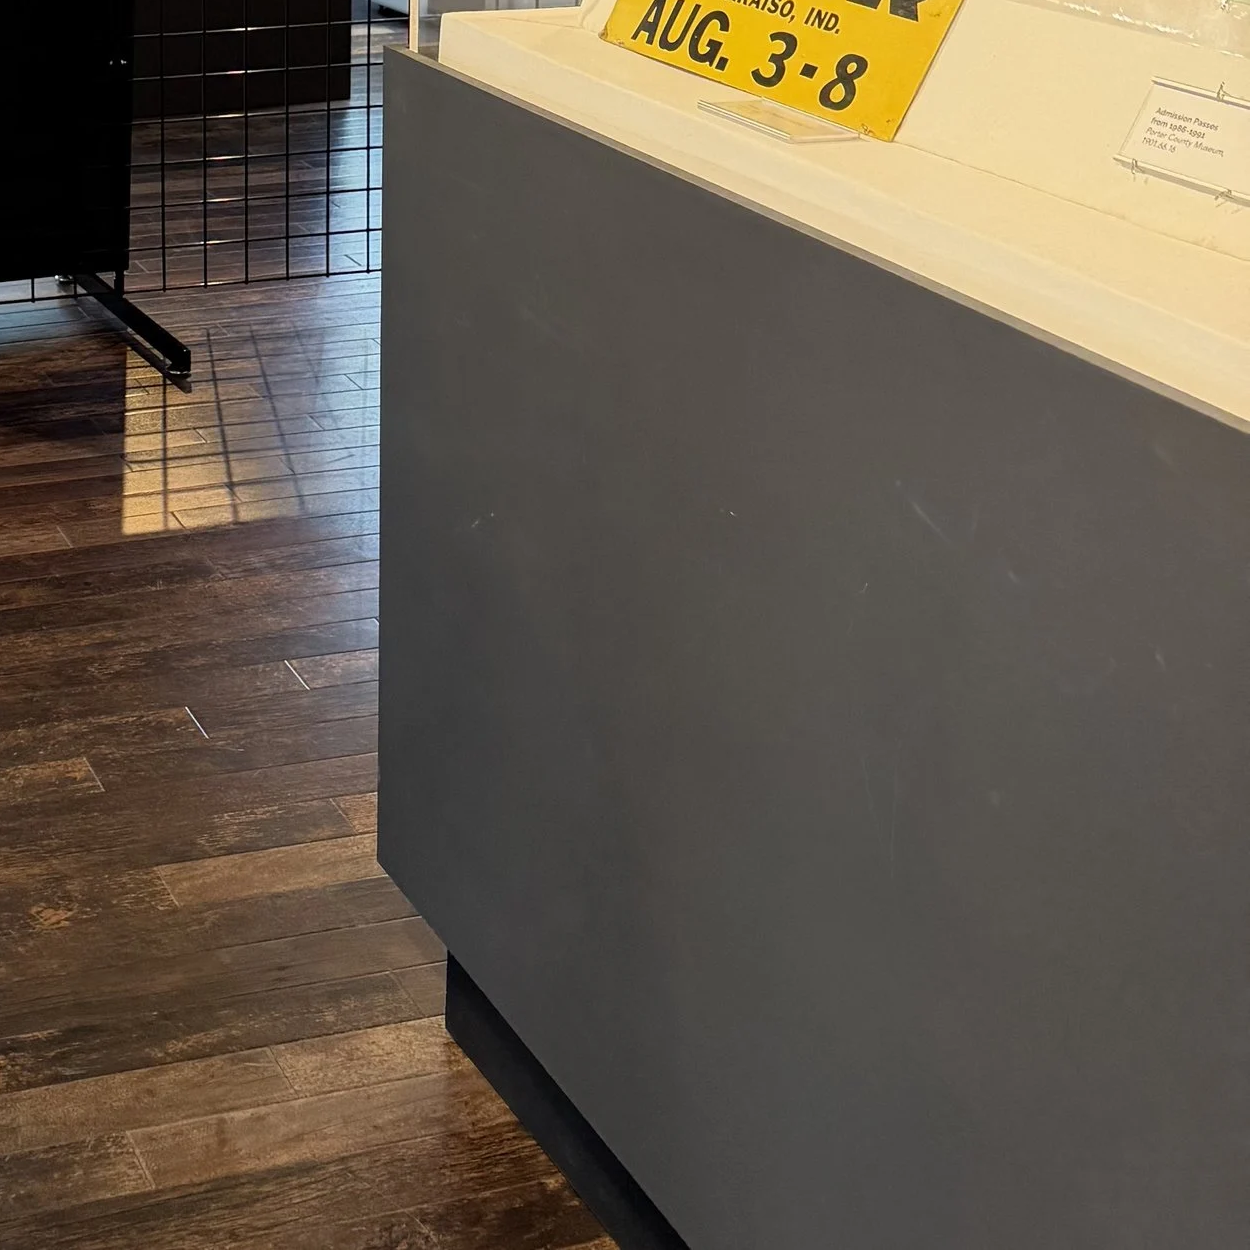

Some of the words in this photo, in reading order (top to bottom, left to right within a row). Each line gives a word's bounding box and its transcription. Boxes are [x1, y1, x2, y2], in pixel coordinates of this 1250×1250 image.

[804, 7, 841, 34] IND.
[1150, 117, 1172, 129] from
[1155, 107, 1193, 124] Admission
[1193, 118, 1219, 132] Passes
[1146, 127, 1167, 138] Porter
[1168, 133, 1193, 147] County
